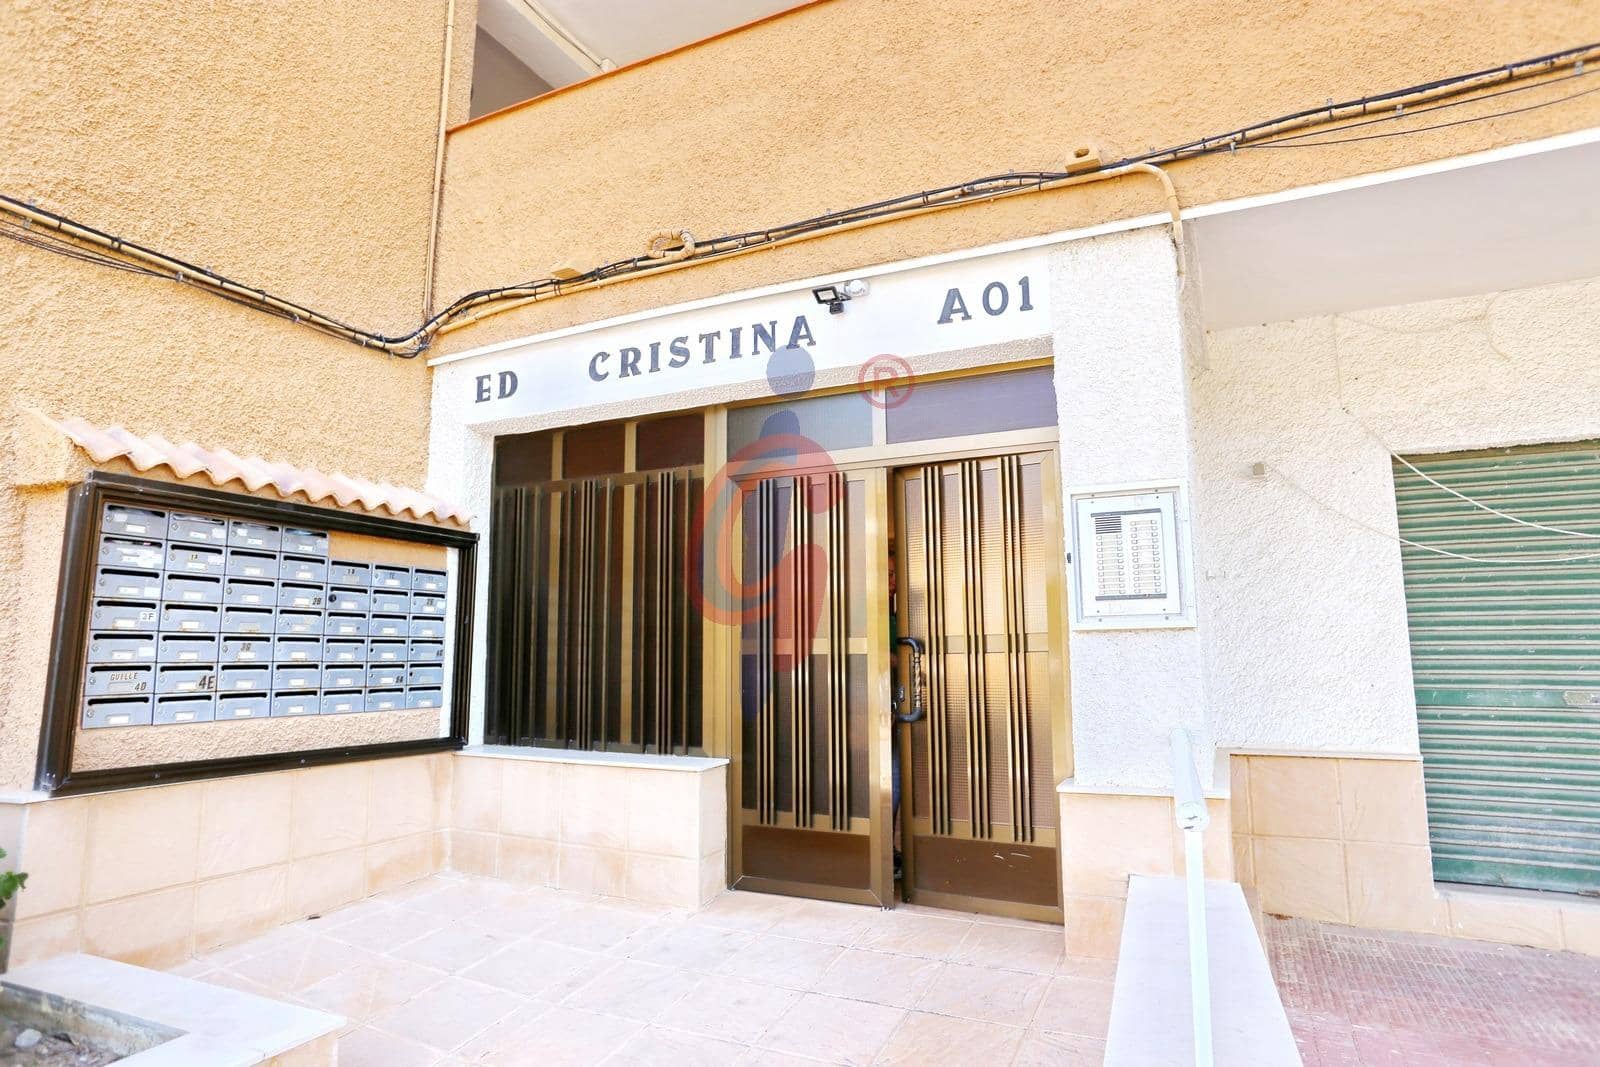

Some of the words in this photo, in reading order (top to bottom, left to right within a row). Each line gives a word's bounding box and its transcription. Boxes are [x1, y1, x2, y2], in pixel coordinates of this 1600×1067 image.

[475, 370, 518, 403] ED
[589, 315, 817, 382] CRISTINA
[110, 672, 138, 681] GUILLE
[198, 675, 215, 689] 4E
